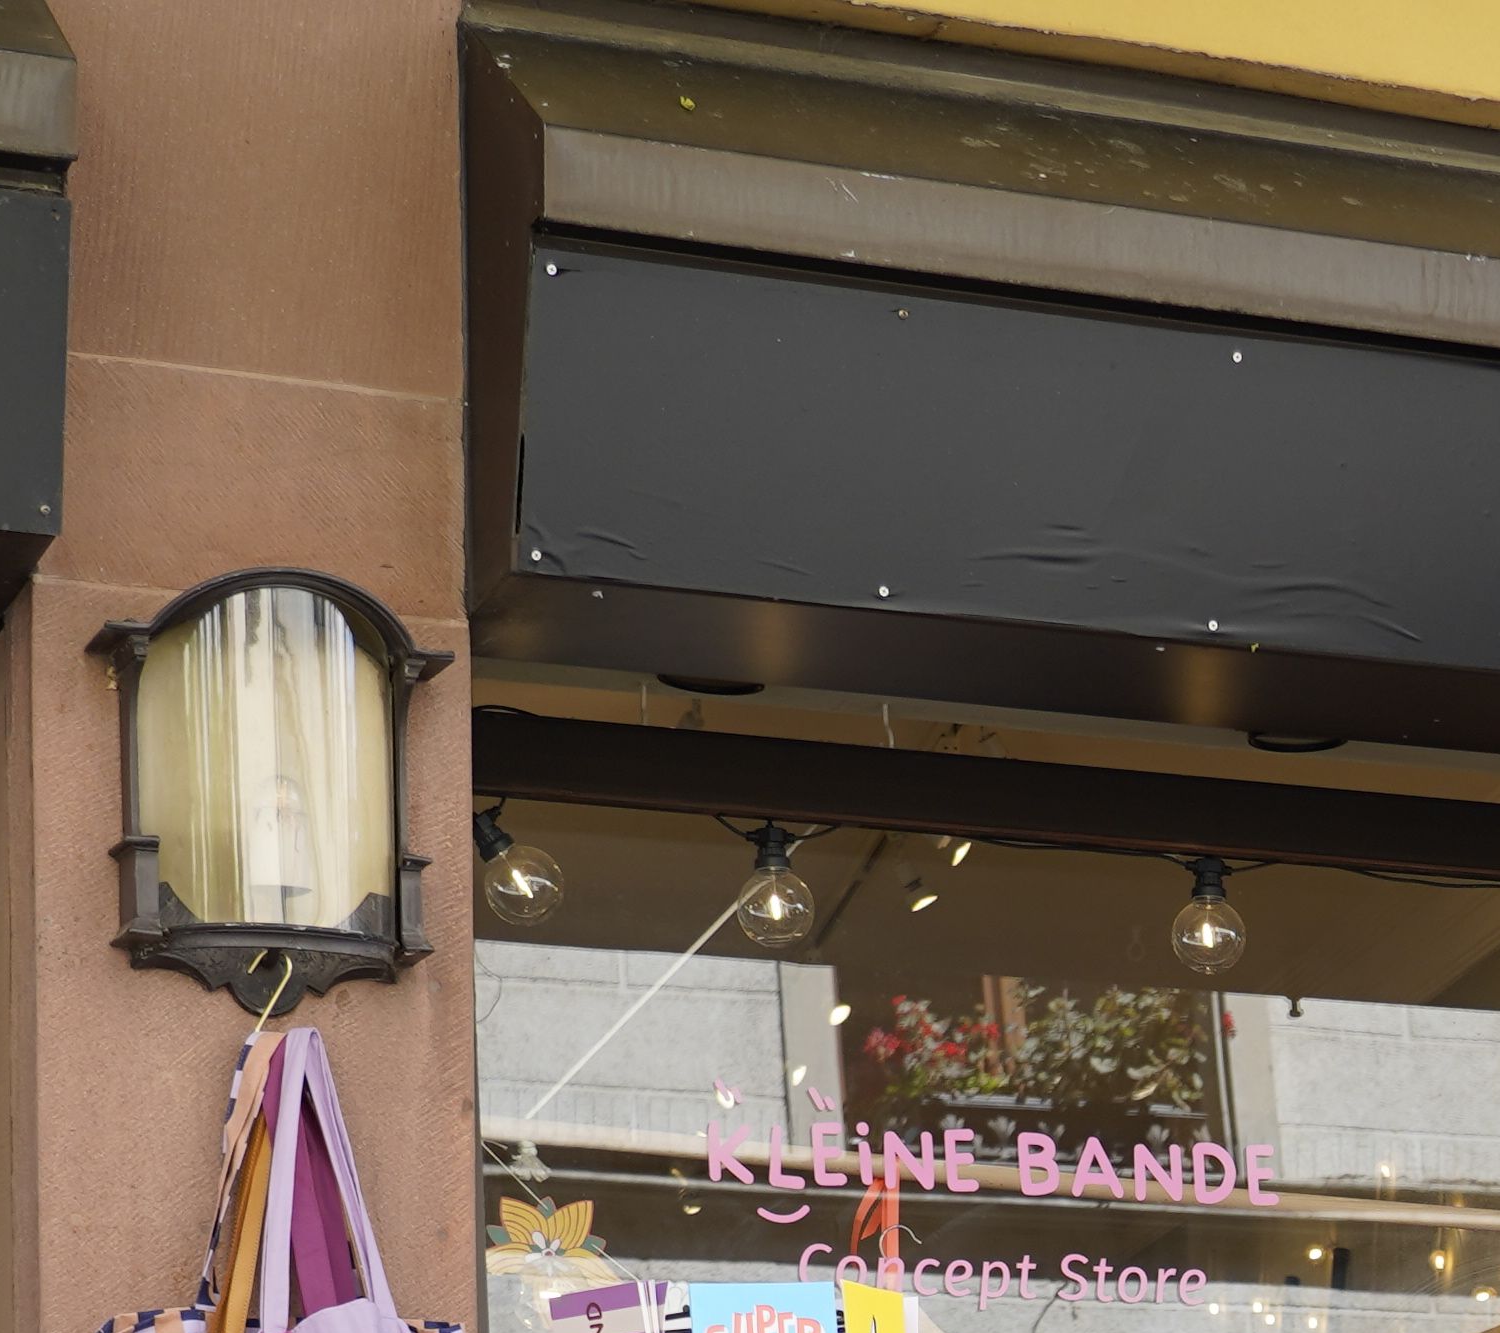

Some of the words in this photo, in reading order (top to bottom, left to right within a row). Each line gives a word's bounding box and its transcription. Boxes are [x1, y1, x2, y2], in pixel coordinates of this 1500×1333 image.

[1017, 1131, 1280, 1206] BANDE
[799, 1243, 1036, 1310] Concept
[1059, 1253, 1207, 1307] Store
